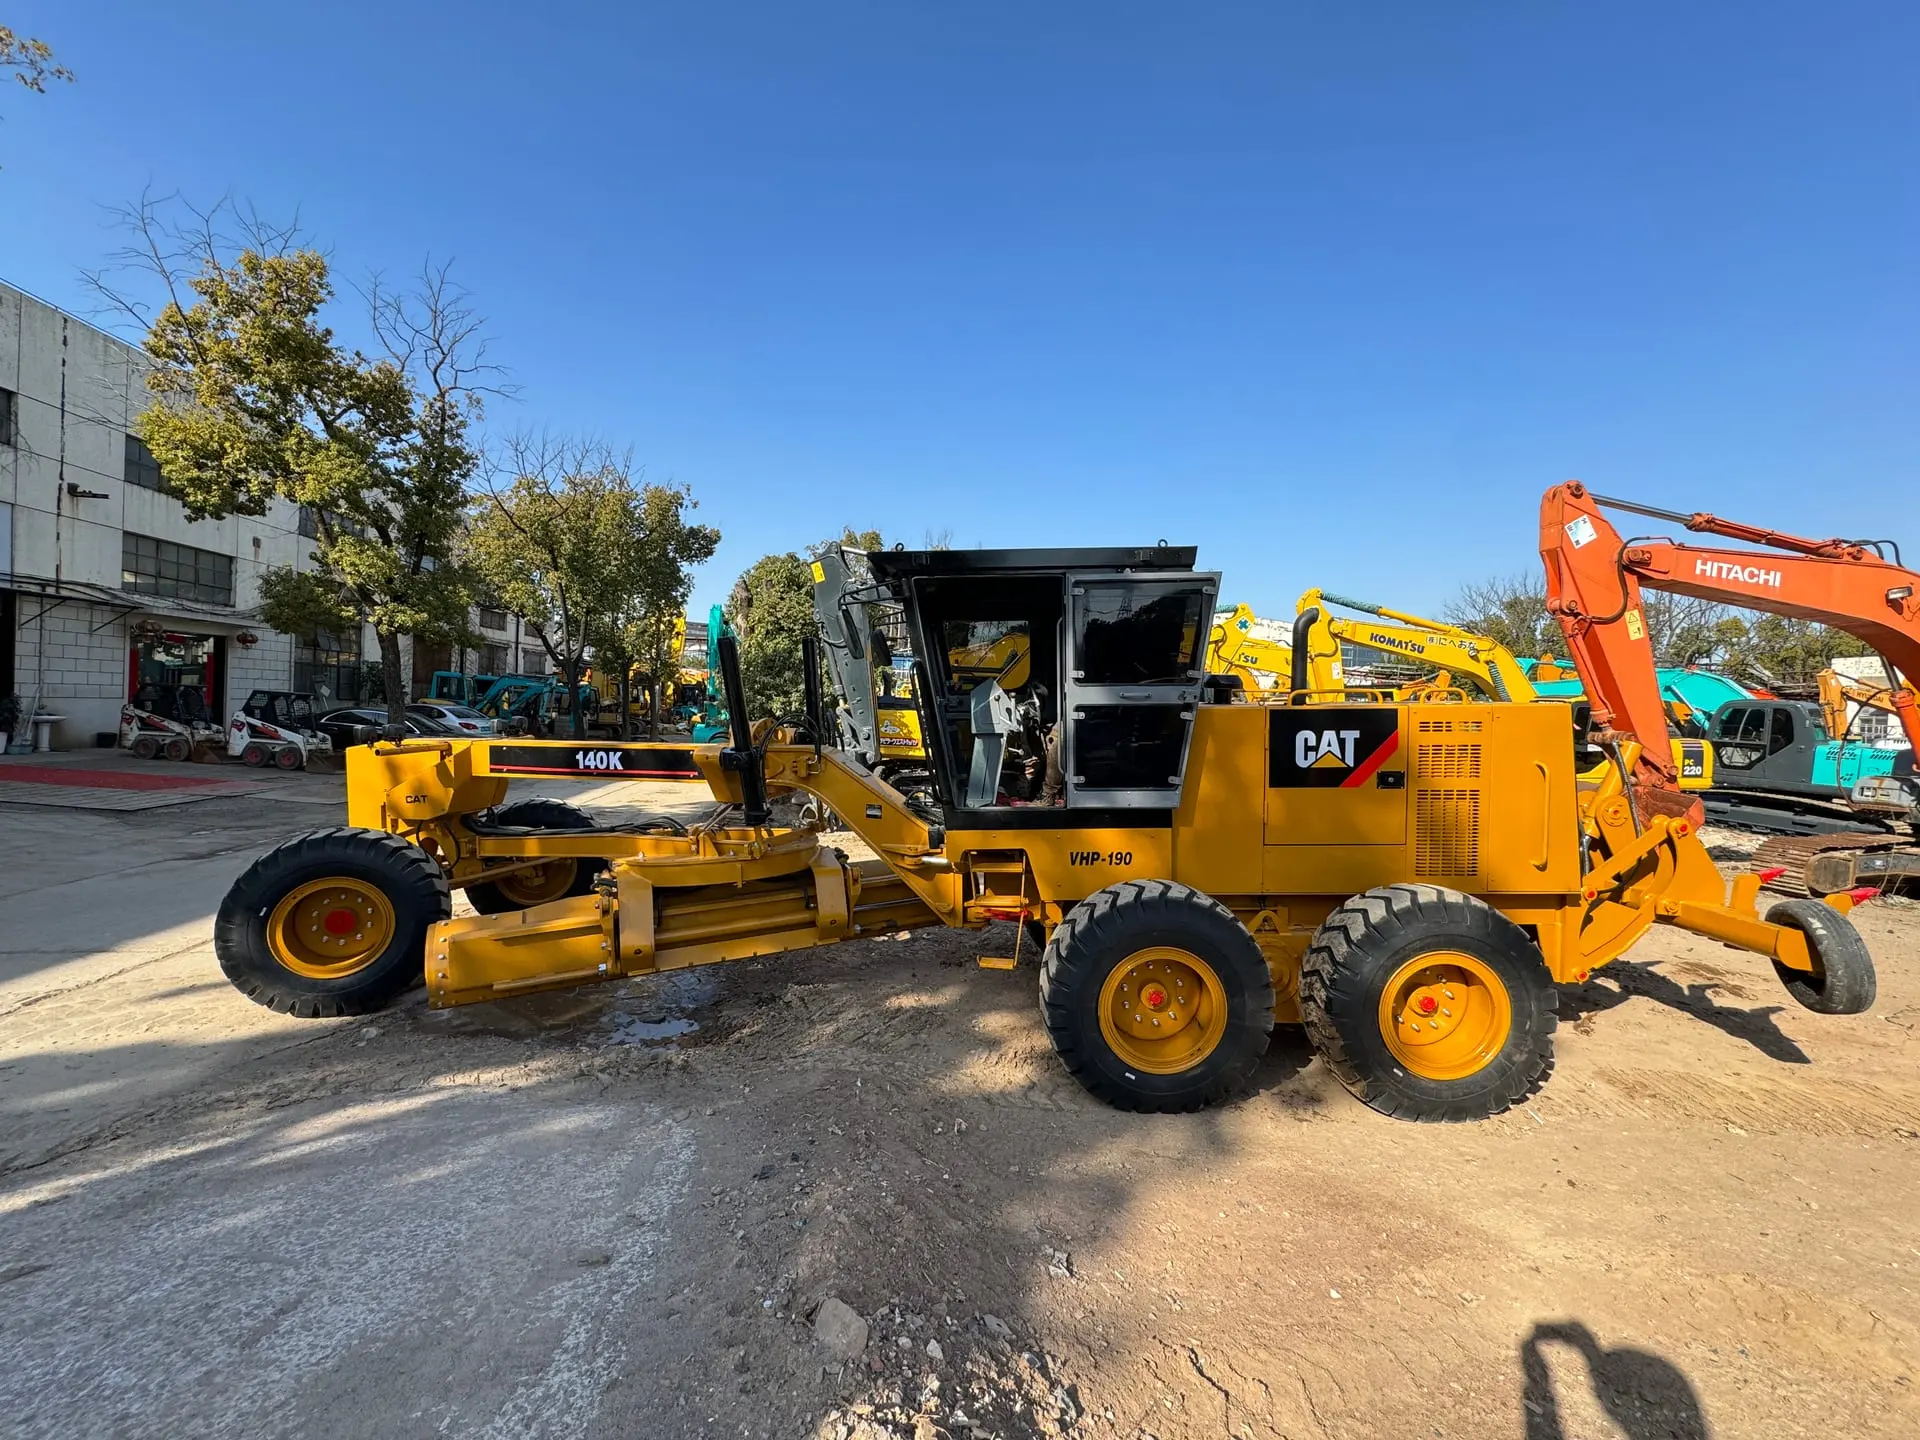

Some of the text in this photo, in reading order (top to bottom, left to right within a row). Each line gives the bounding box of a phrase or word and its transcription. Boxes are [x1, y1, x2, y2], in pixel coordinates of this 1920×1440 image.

[1695, 559, 1782, 587] HITACHI
[1369, 632, 1426, 654] KOMATSU
[1295, 730, 1360, 768] CAT
[575, 750, 624, 770] 140K
[1684, 758, 1695, 766] PC
[1683, 766, 1702, 775] 220
[405, 795, 428, 804] CAT
[1069, 851, 1133, 866] VHP-190
